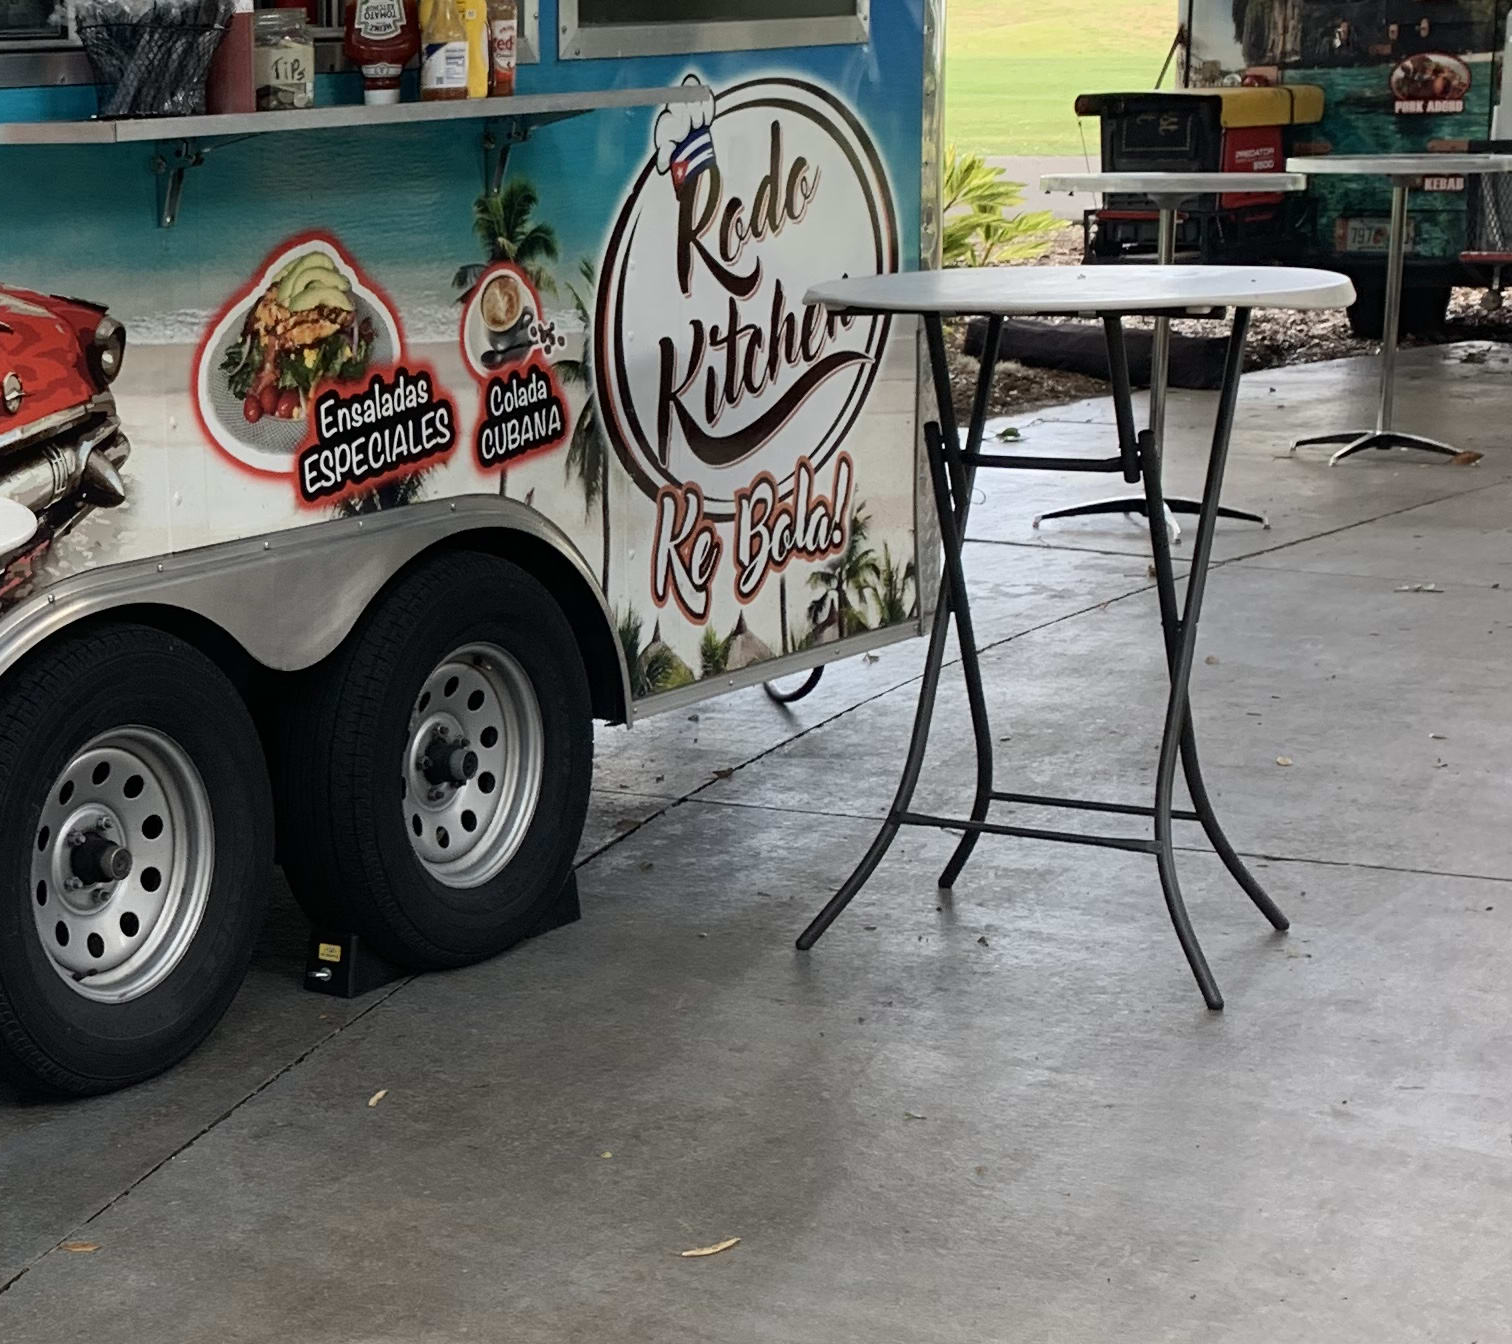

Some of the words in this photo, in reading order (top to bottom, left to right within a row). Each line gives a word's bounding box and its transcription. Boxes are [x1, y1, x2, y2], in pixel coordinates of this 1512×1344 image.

[363, 9, 397, 20] TOMATO
[675, 120, 821, 299] Rodo
[1424, 177, 1464, 191] KEBAB
[320, 374, 430, 438] Ensaladas
[490, 372, 548, 416] Colada
[303, 406, 451, 494] ESPECIALES
[481, 404, 562, 460] CUBANA
[654, 484, 720, 622] Ke
[736, 453, 852, 602] Bola!
